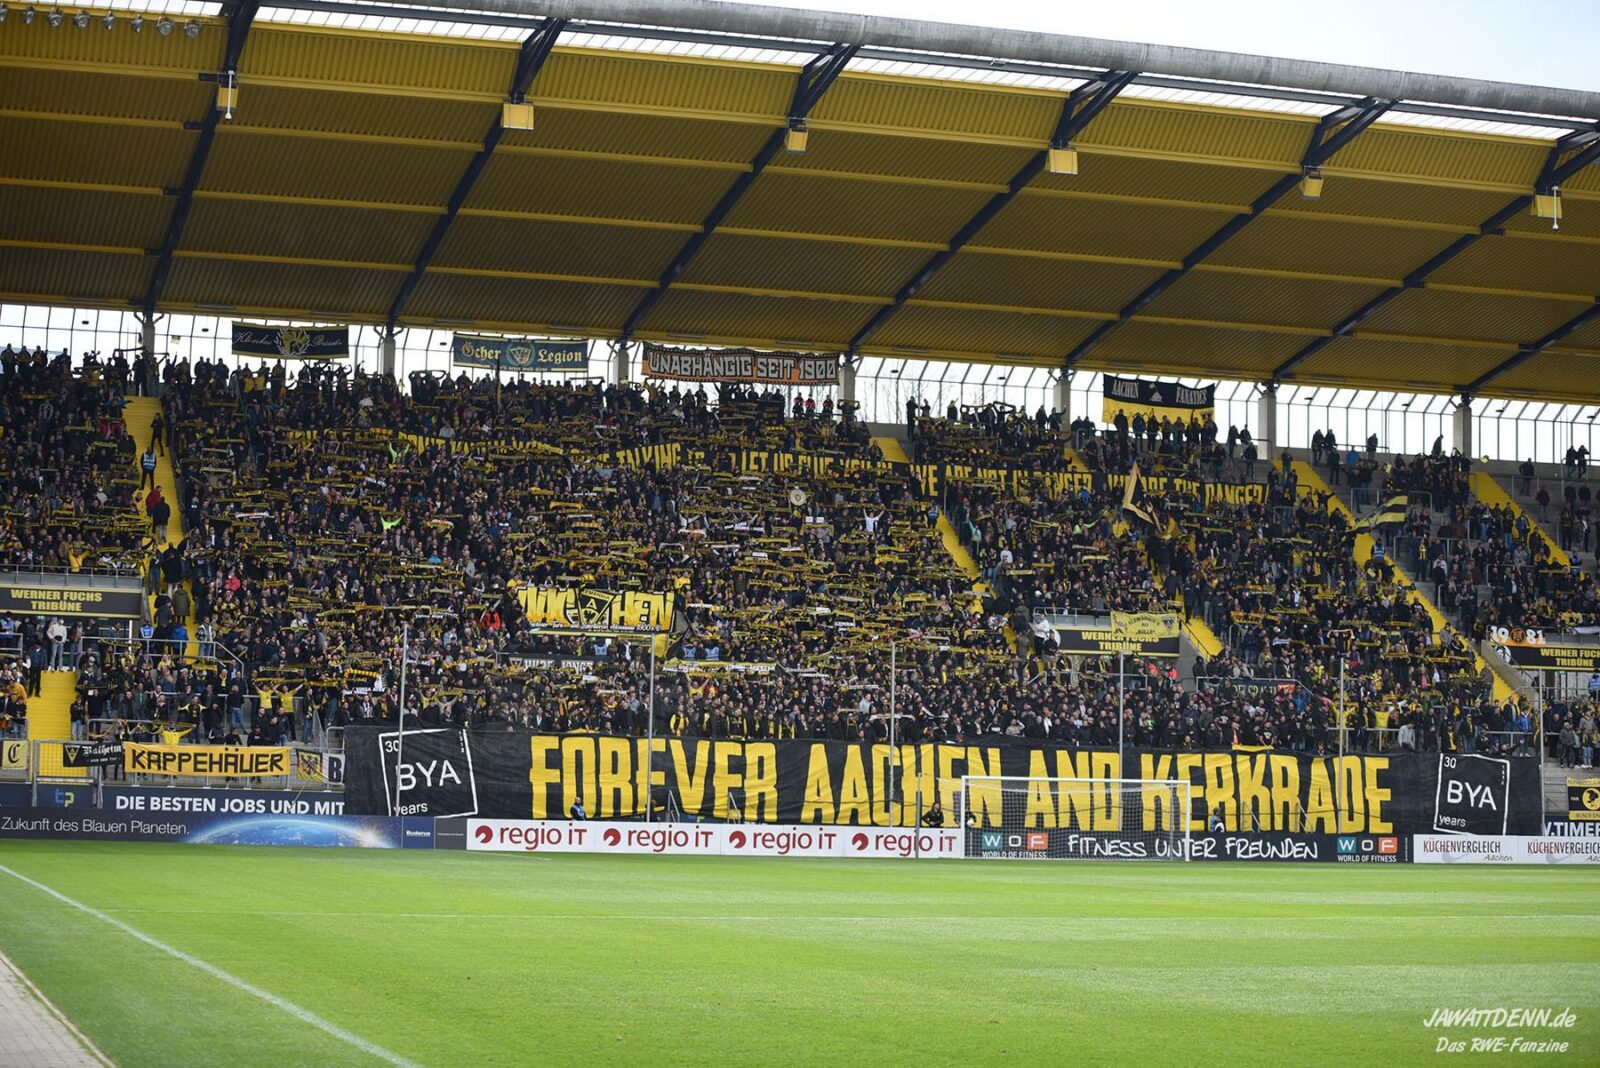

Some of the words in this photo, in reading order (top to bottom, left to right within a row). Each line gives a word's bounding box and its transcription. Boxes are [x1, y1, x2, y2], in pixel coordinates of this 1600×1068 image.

[461, 341, 501, 361] Öcher
[537, 349, 582, 365] Legion
[649, 350, 754, 377] UNABHÄNGIG
[757, 358, 794, 380] SEIT
[800, 360, 837, 379] 1900
[909, 464, 939, 497] WE
[11, 589, 61, 600] WERNER
[63, 592, 103, 602] FUCHS
[31, 600, 82, 612] TRIBÜNE
[1540, 648, 1579, 657] WERNER
[1555, 656, 1594, 667] TRIBÜNE
[131, 748, 284, 773] KAPPEHÄUER
[1443, 756, 1457, 769] 30
[396, 759, 462, 791] BYA
[529, 735, 778, 822] FOREVER
[800, 743, 1001, 829] AACHEN
[1025, 750, 1120, 831] AND
[1140, 753, 1393, 834] KERKRADE
[115, 795, 146, 810] DIE
[149, 797, 216, 812] BESTEN
[219, 798, 266, 814] JOBS
[270, 800, 310, 814] UND
[313, 801, 345, 815] MIT
[1446, 779, 1497, 811] BYA
[1, 816, 51, 831] Zukunft
[53, 819, 79, 832] des
[82, 819, 127, 833] Blauen
[130, 820, 190, 835] Planeten.
[1438, 814, 1467, 828] years
[499, 823, 562, 850] regio
[627, 825, 688, 852] regio
[753, 827, 814, 854] regio
[875, 829, 934, 857] regio
[1067, 834, 1148, 857] FITNESS
[1155, 838, 1218, 858] UNTER
[1225, 837, 1318, 859] FREUNDEN
[1423, 839, 1501, 853] KÜCHENVERGLEICH
